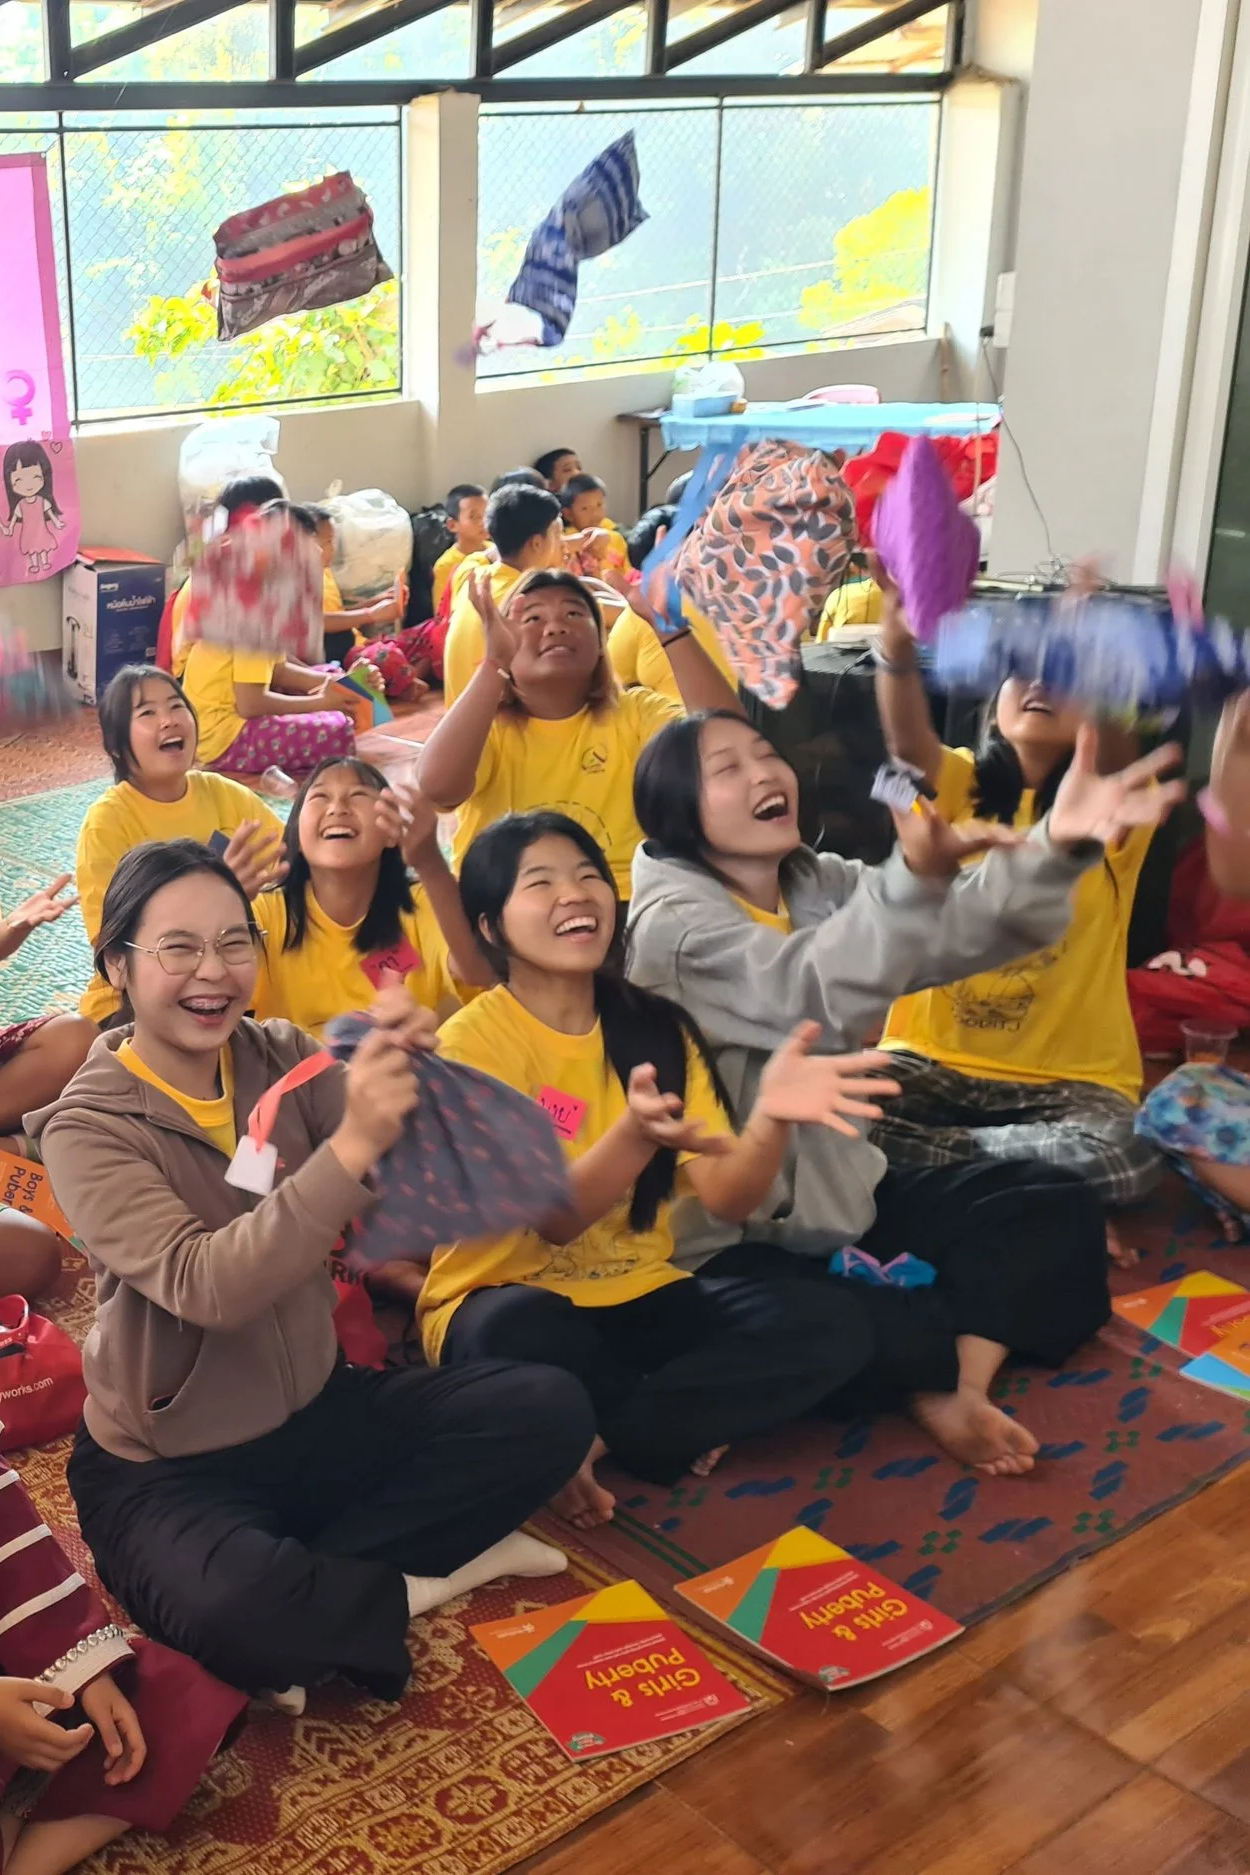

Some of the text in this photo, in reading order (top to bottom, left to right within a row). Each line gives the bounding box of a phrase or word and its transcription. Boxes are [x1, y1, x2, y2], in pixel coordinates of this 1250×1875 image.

[5, 1166, 27, 1206] Puber
[25, 1172, 44, 1202] Boys
[800, 1581, 887, 1630] Puberty
[853, 1599, 908, 1630] Girls
[831, 1624, 857, 1641] &
[584, 1647, 687, 1690] Puberty
[610, 1668, 701, 1708] Girls &
